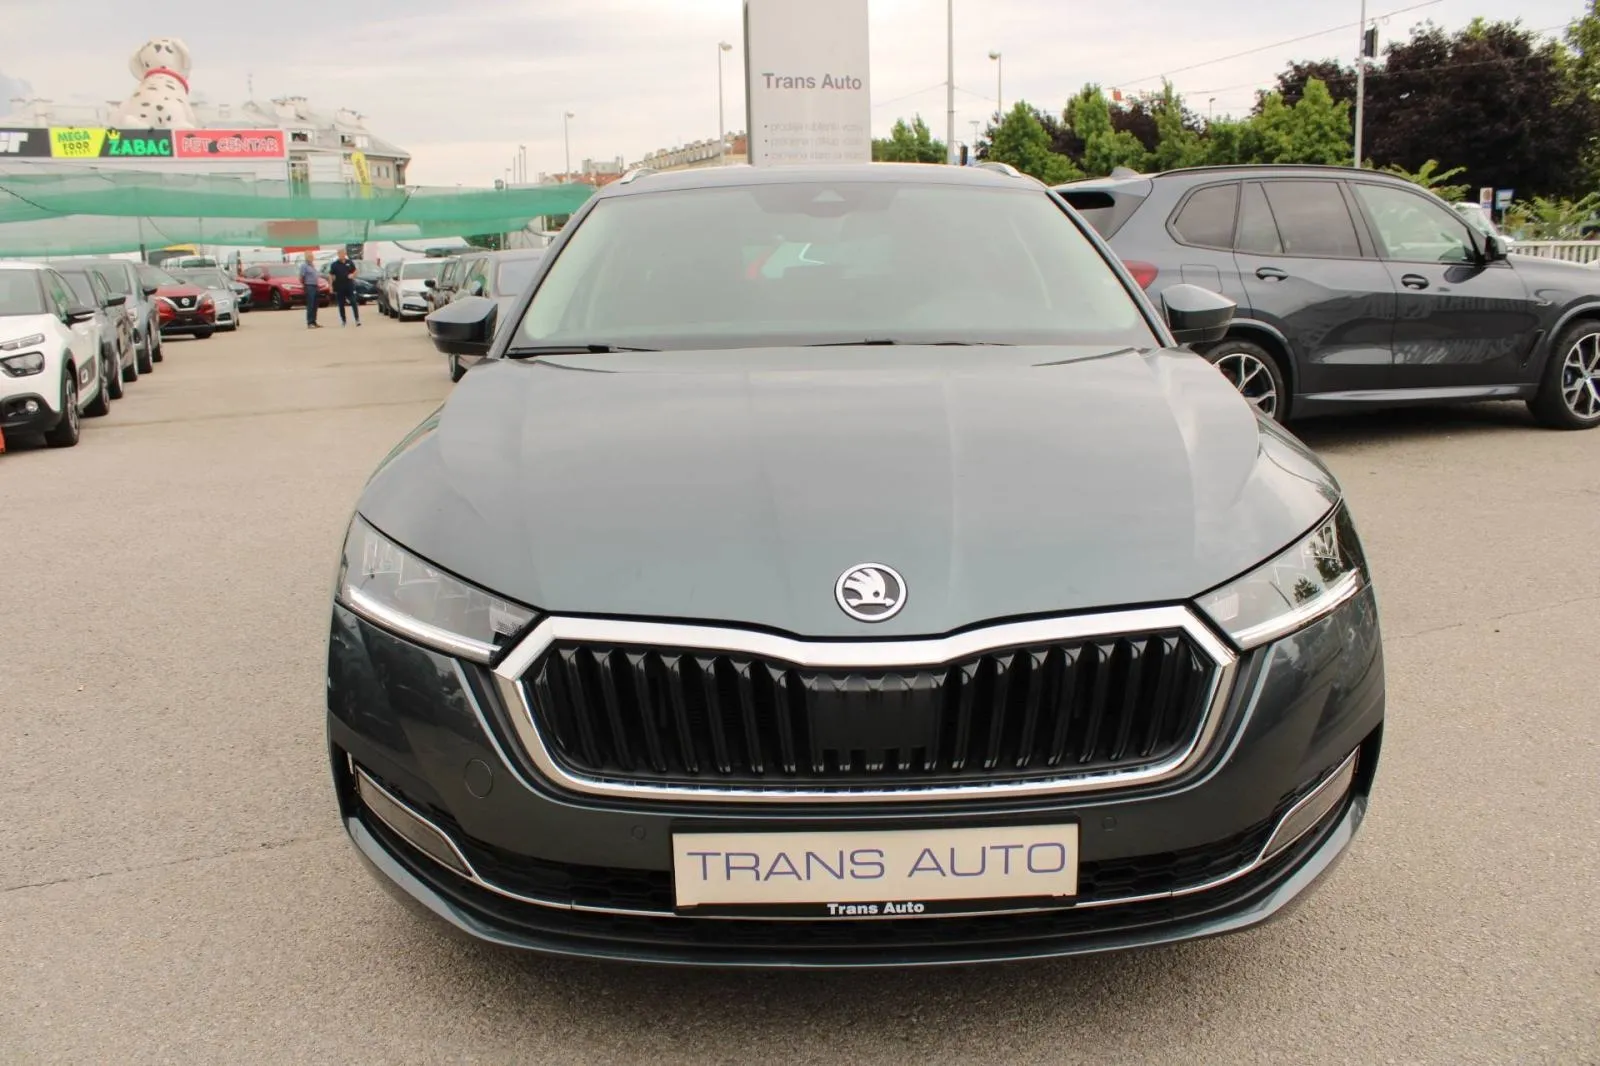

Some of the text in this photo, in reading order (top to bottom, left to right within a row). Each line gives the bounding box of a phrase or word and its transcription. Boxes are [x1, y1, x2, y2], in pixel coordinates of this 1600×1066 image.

[762, 73, 862, 90] Trans Auto
[57, 131, 91, 143] MEGA
[183, 137, 279, 153] PET CENTAR
[687, 842, 1066, 882] TRANS AUTO
[827, 901, 925, 915] Trans Auto
